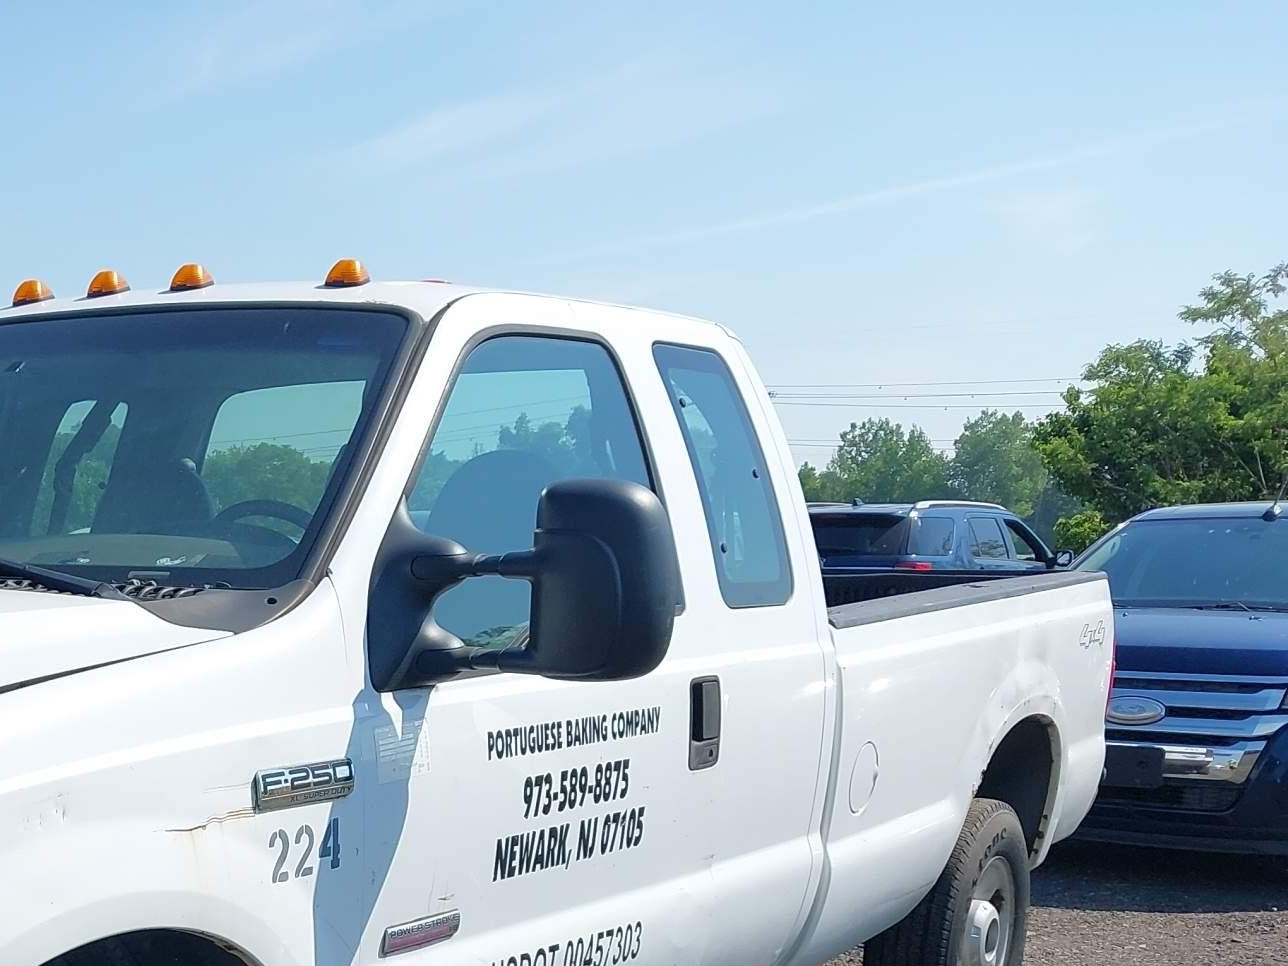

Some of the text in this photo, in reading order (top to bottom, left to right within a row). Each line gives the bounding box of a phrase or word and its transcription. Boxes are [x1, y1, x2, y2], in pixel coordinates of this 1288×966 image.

[488, 707, 661, 761] PORTUGUESE BAKING COMPANY
[523, 760, 630, 819] 973-589-8875
[268, 817, 341, 884] 224
[492, 807, 645, 882] NEWARK, NJ 07105
